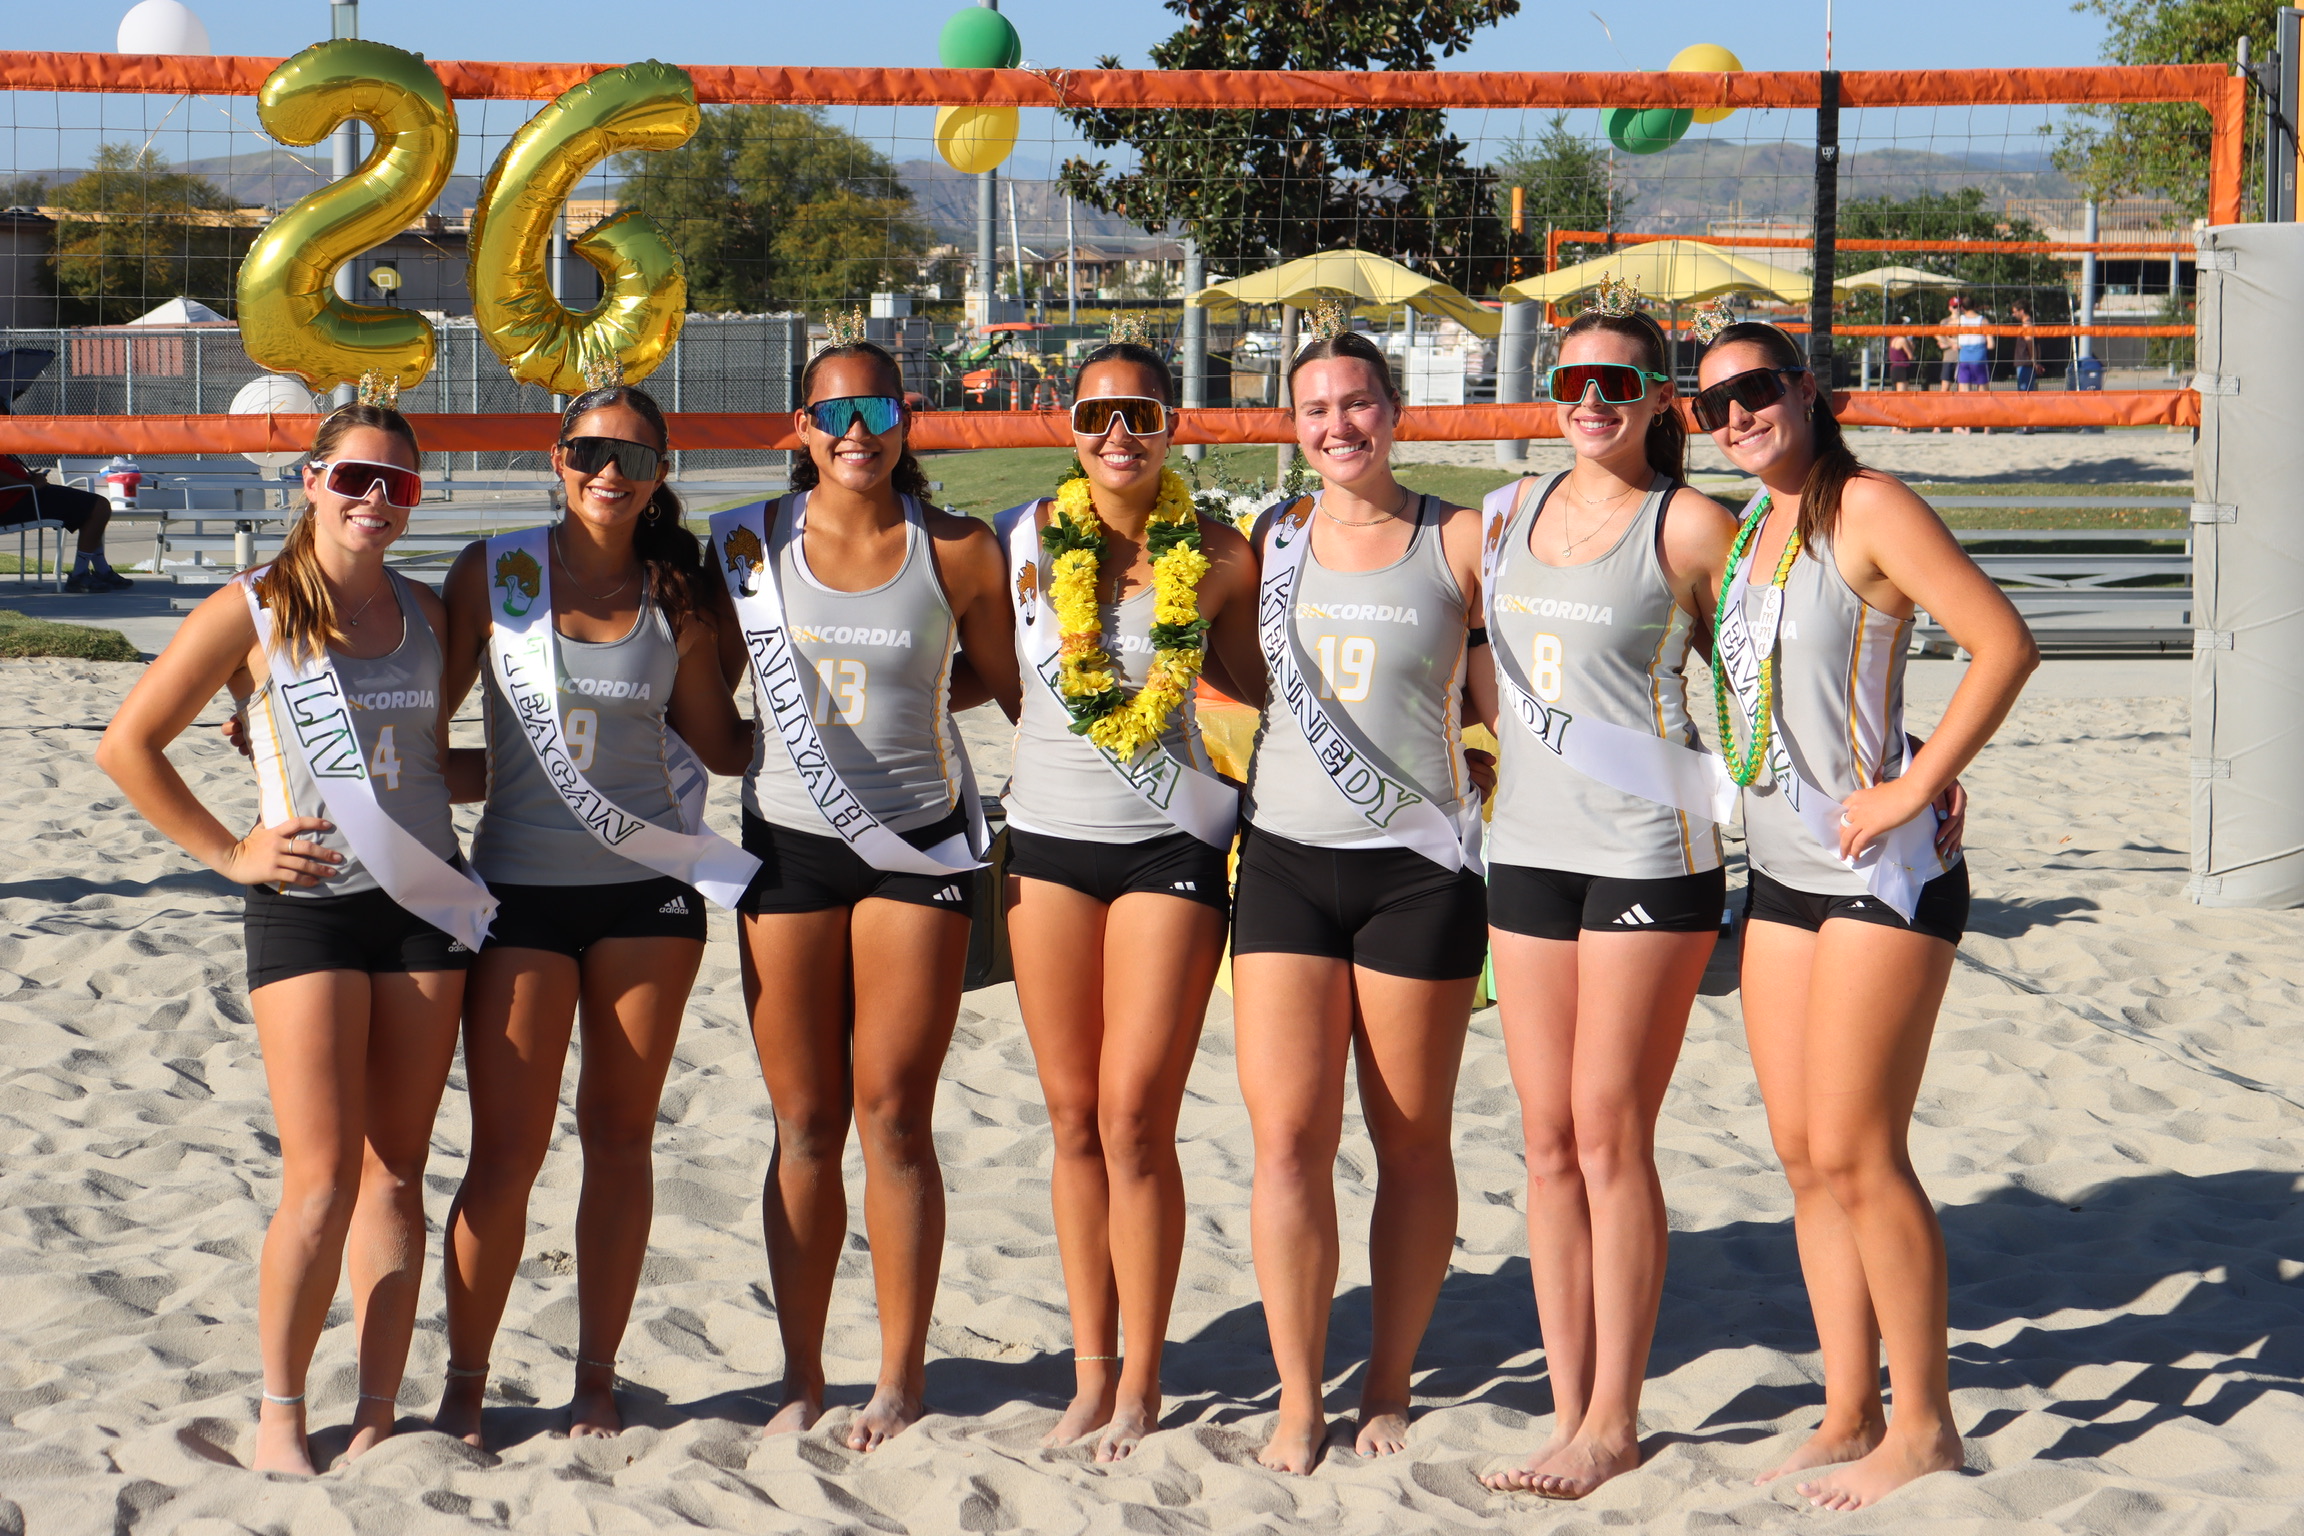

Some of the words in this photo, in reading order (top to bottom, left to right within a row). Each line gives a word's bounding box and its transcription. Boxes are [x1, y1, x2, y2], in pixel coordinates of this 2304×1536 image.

[788, 625, 911, 648] ONCORDIA
[1493, 594, 1612, 625] CONCORDIA
[347, 690, 435, 711] NCORDIA
[814, 658, 868, 726] 13
[1260, 566, 1422, 828] KENNEDY
[1314, 635, 1377, 702] 19
[1531, 632, 1564, 703] 8
[281, 672, 365, 779] LIV
[370, 724, 402, 791] 4
[504, 636, 645, 845] TEAGAN
[564, 708, 598, 772] 9
[746, 626, 879, 842] ALIYAH
[659, 906, 689, 914] adidas
